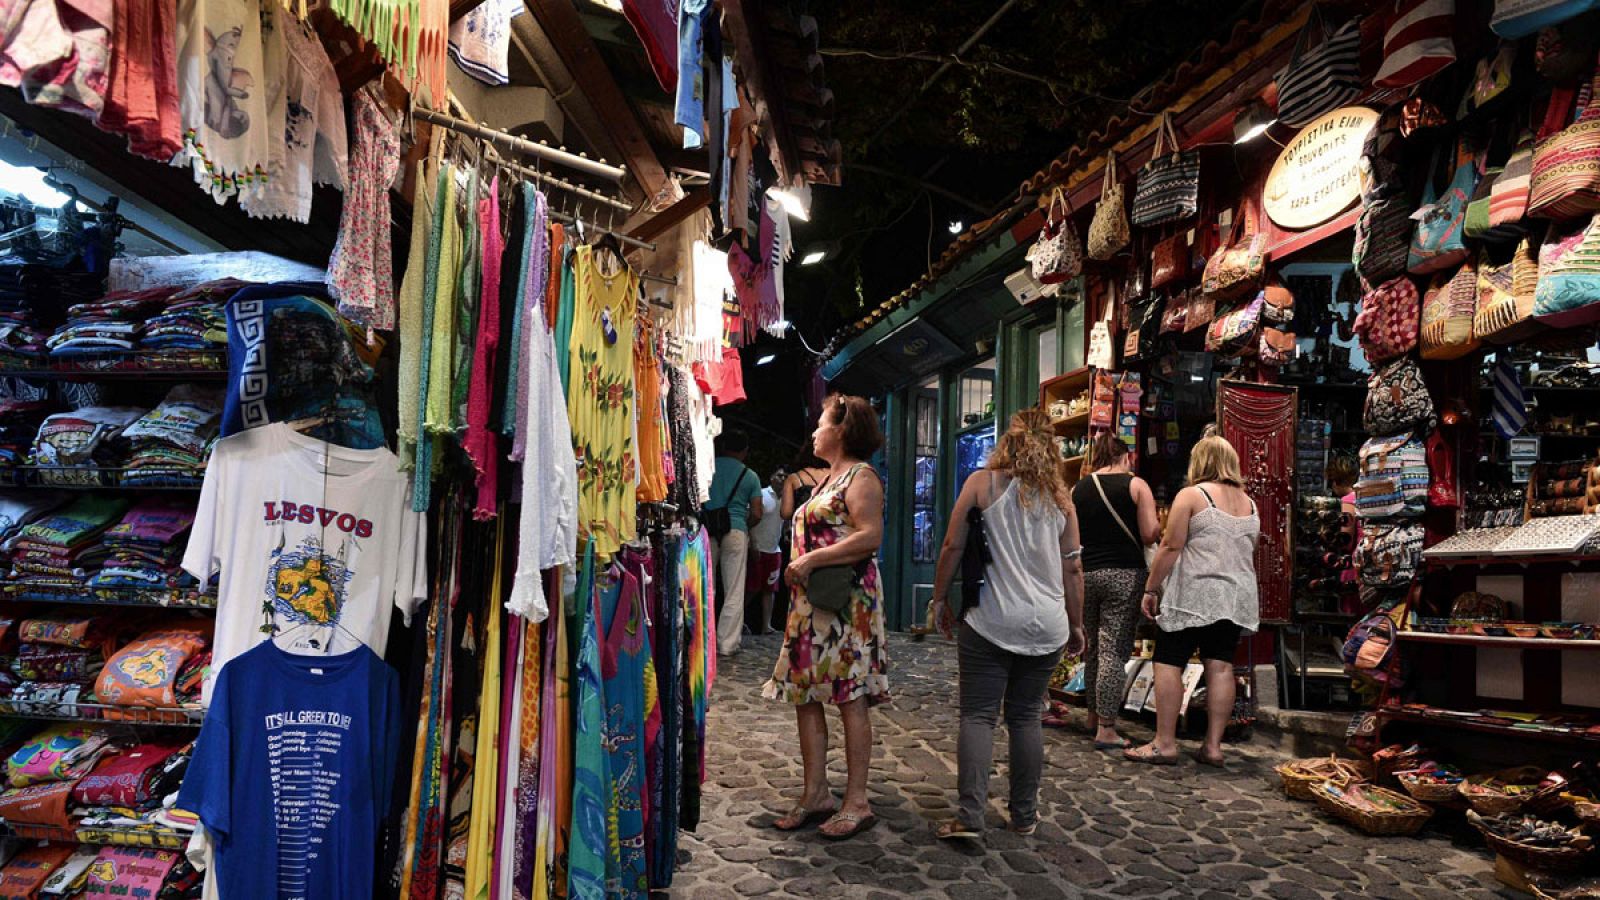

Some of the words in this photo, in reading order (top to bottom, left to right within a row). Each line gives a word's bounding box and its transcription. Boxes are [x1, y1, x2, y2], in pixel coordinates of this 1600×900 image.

[264, 500, 373, 538] LESVOS
[298, 710, 326, 723] GREEK
[327, 711, 340, 725] TO
